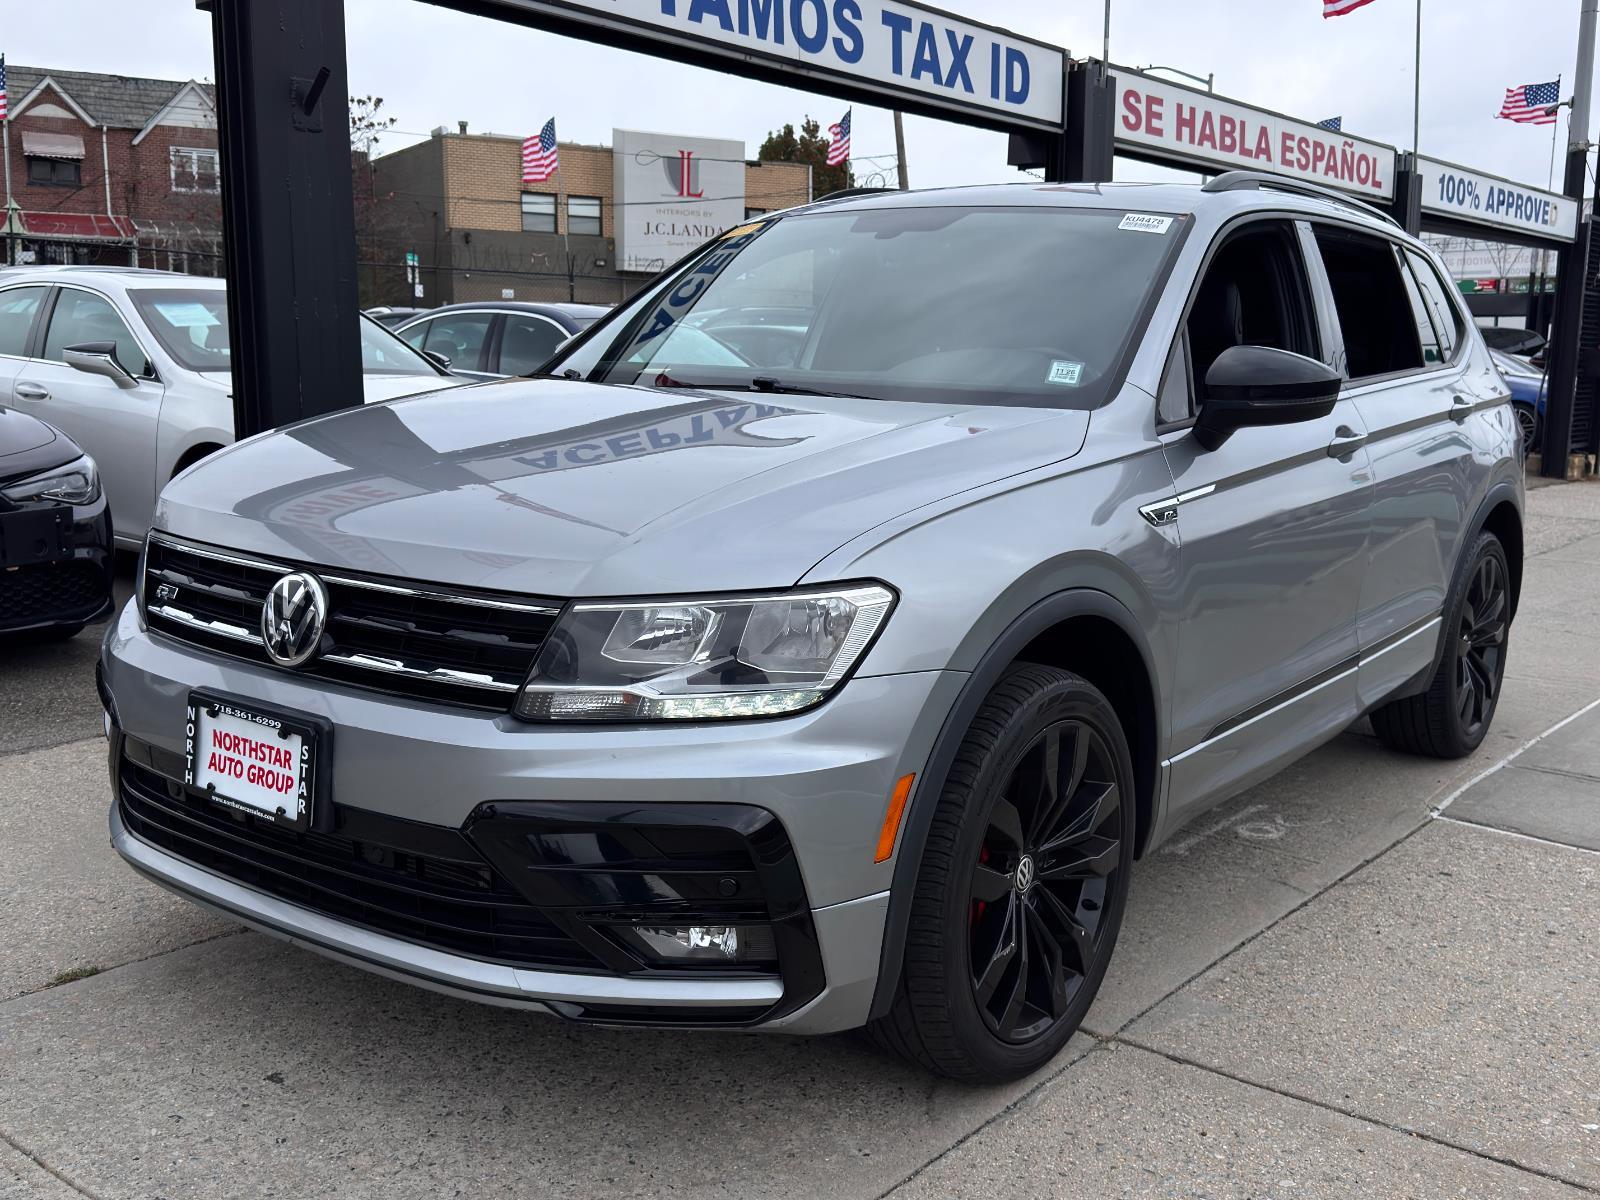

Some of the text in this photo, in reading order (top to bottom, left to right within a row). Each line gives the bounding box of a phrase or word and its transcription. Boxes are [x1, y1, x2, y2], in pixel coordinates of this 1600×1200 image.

[660, 0, 1031, 105] MOS TAX ID
[1121, 89, 1382, 189] SE HABLA ESPAÑOL
[656, 208, 713, 218] INTERIORS BY
[1438, 173, 1480, 210] 100%
[213, 703, 282, 729] 718-361-6299
[185, 706, 196, 785] NORTH
[212, 729, 292, 770] NORTHSTAR
[208, 752, 294, 795] AUTO GROUP
[298, 745, 309, 814] STAR
